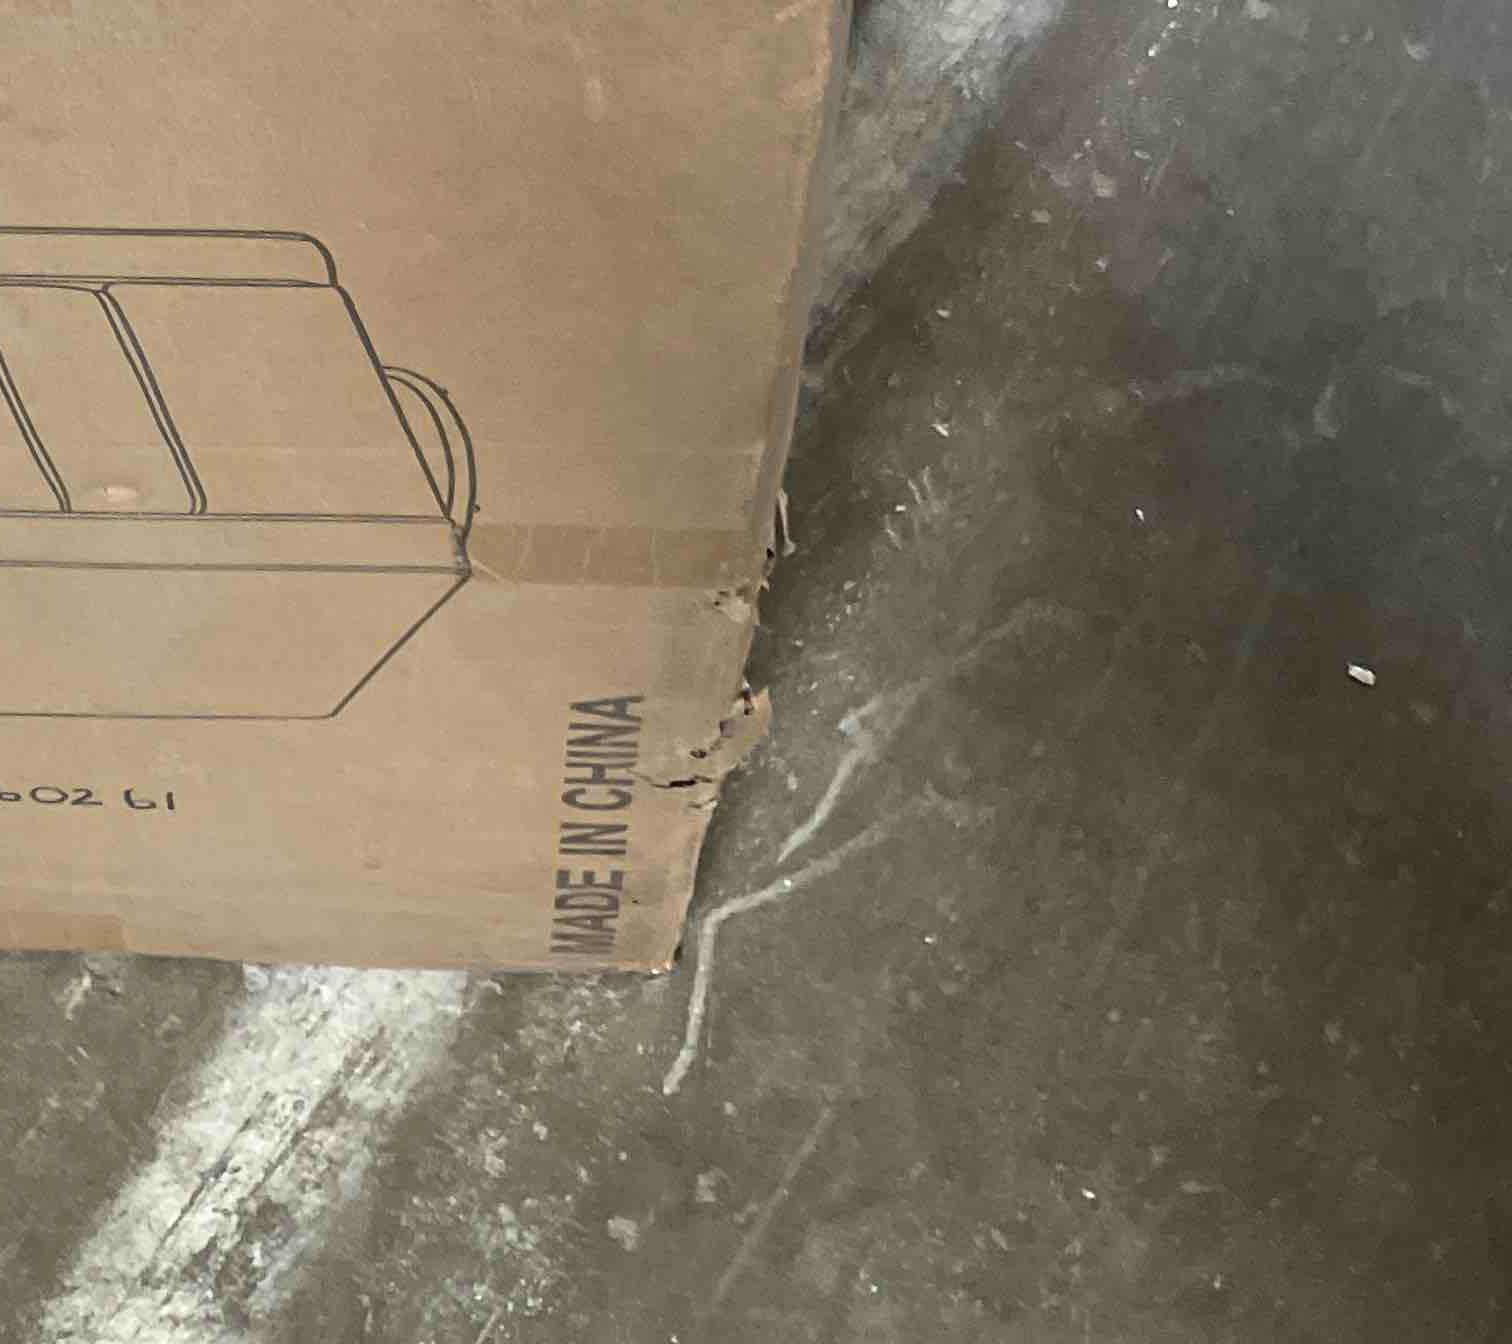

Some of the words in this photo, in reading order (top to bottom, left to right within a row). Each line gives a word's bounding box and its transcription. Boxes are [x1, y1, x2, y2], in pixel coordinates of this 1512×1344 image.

[563, 695, 644, 812] CHINA
[559, 821, 628, 857] IN
[549, 868, 625, 956] MADE
